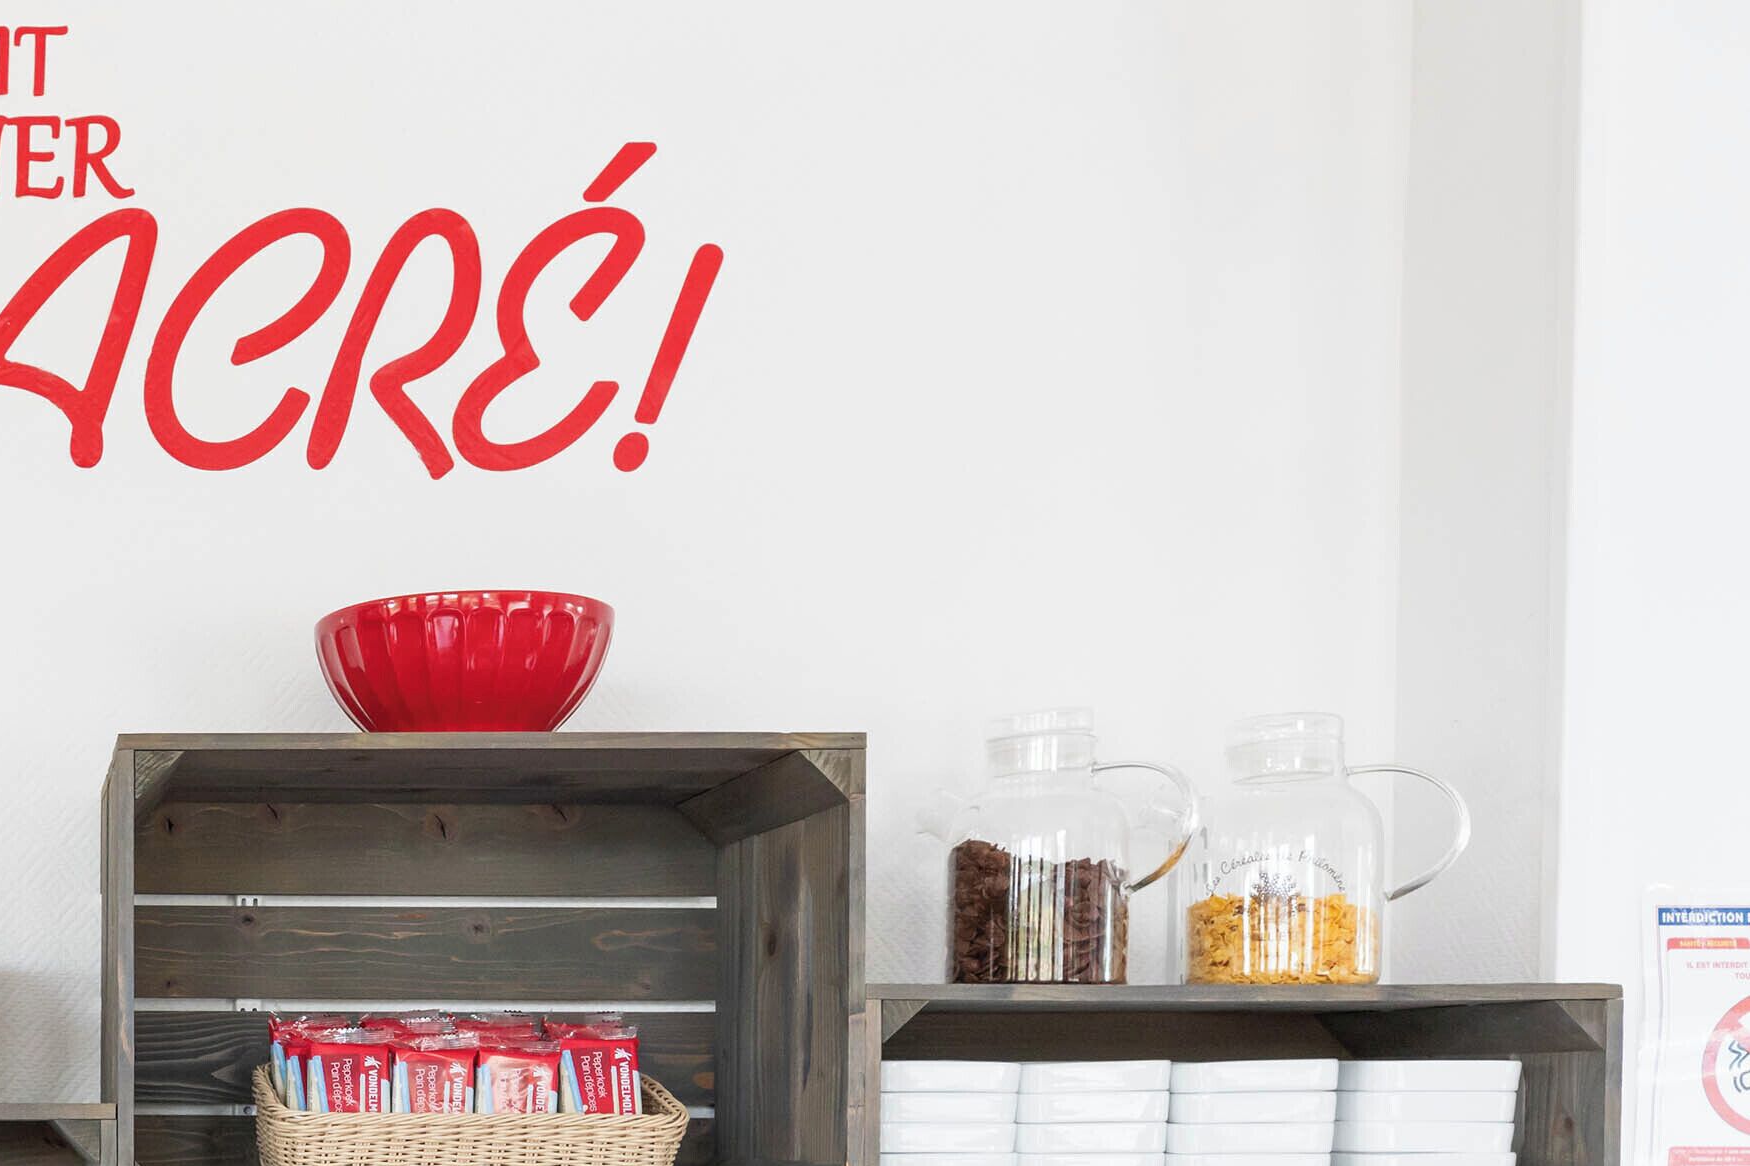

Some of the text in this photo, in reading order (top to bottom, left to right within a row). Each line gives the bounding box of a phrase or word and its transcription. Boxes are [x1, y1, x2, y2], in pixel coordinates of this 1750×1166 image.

[1661, 911, 1744, 924] INTERDICTION
[592, 1051, 608, 1098] Peperkoek
[619, 1061, 633, 1115] VONDELMOL
[535, 1080, 547, 1113] VONDE
